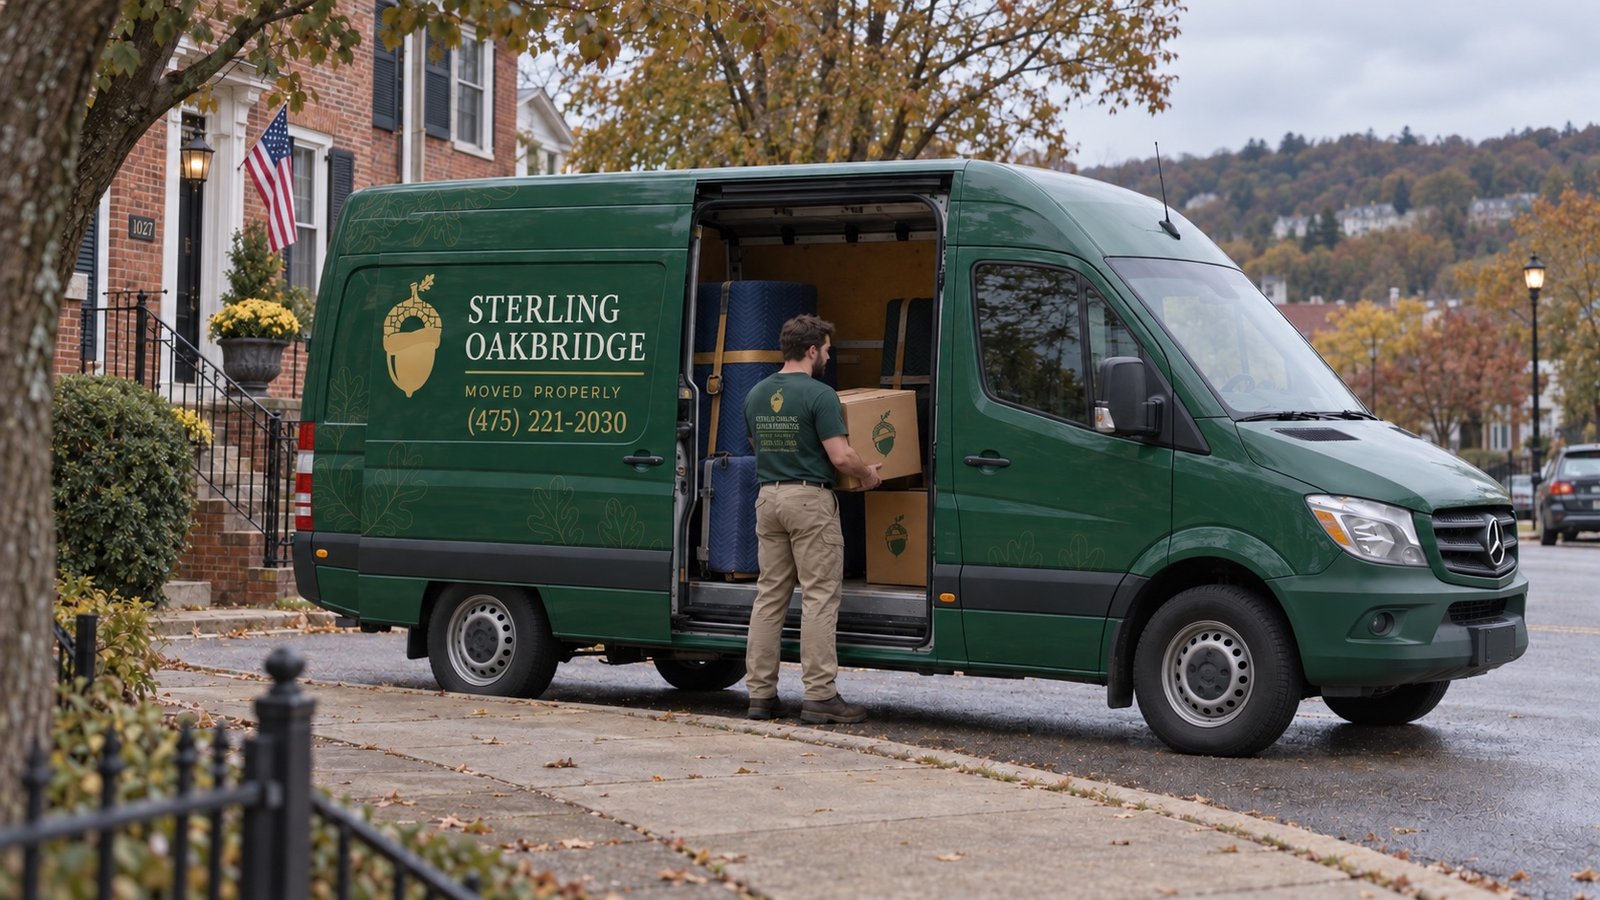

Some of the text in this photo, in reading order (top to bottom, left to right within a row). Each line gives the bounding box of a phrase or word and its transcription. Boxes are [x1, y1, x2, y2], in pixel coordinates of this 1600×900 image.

[133, 219, 153, 236] 1027
[468, 294, 620, 323] STERLING
[465, 332, 646, 361] OAKBRIDGE
[465, 385, 621, 399] MOVED PROPERLY
[467, 407, 627, 437] (475) 221-2030
